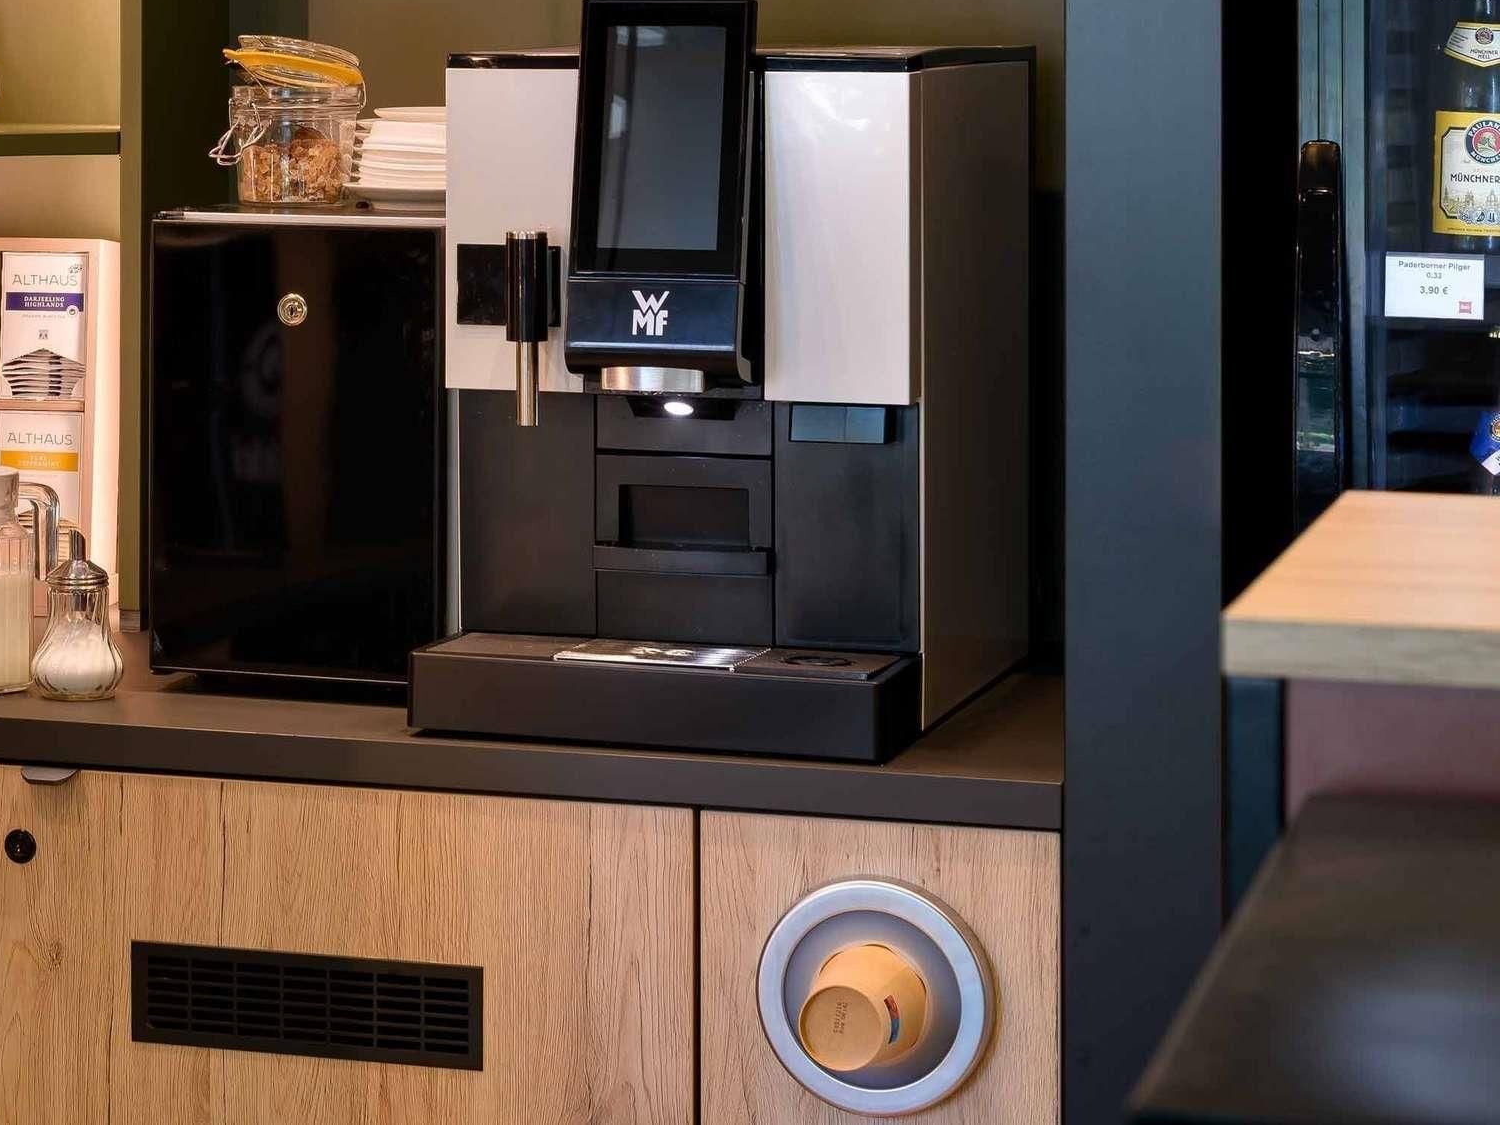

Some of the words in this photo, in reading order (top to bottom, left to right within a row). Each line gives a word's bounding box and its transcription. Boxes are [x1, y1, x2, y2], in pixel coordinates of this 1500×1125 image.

[11, 274, 79, 286] ALTHAUS
[631, 290, 670, 336] WMF
[7, 431, 74, 446] ALTHAUS
